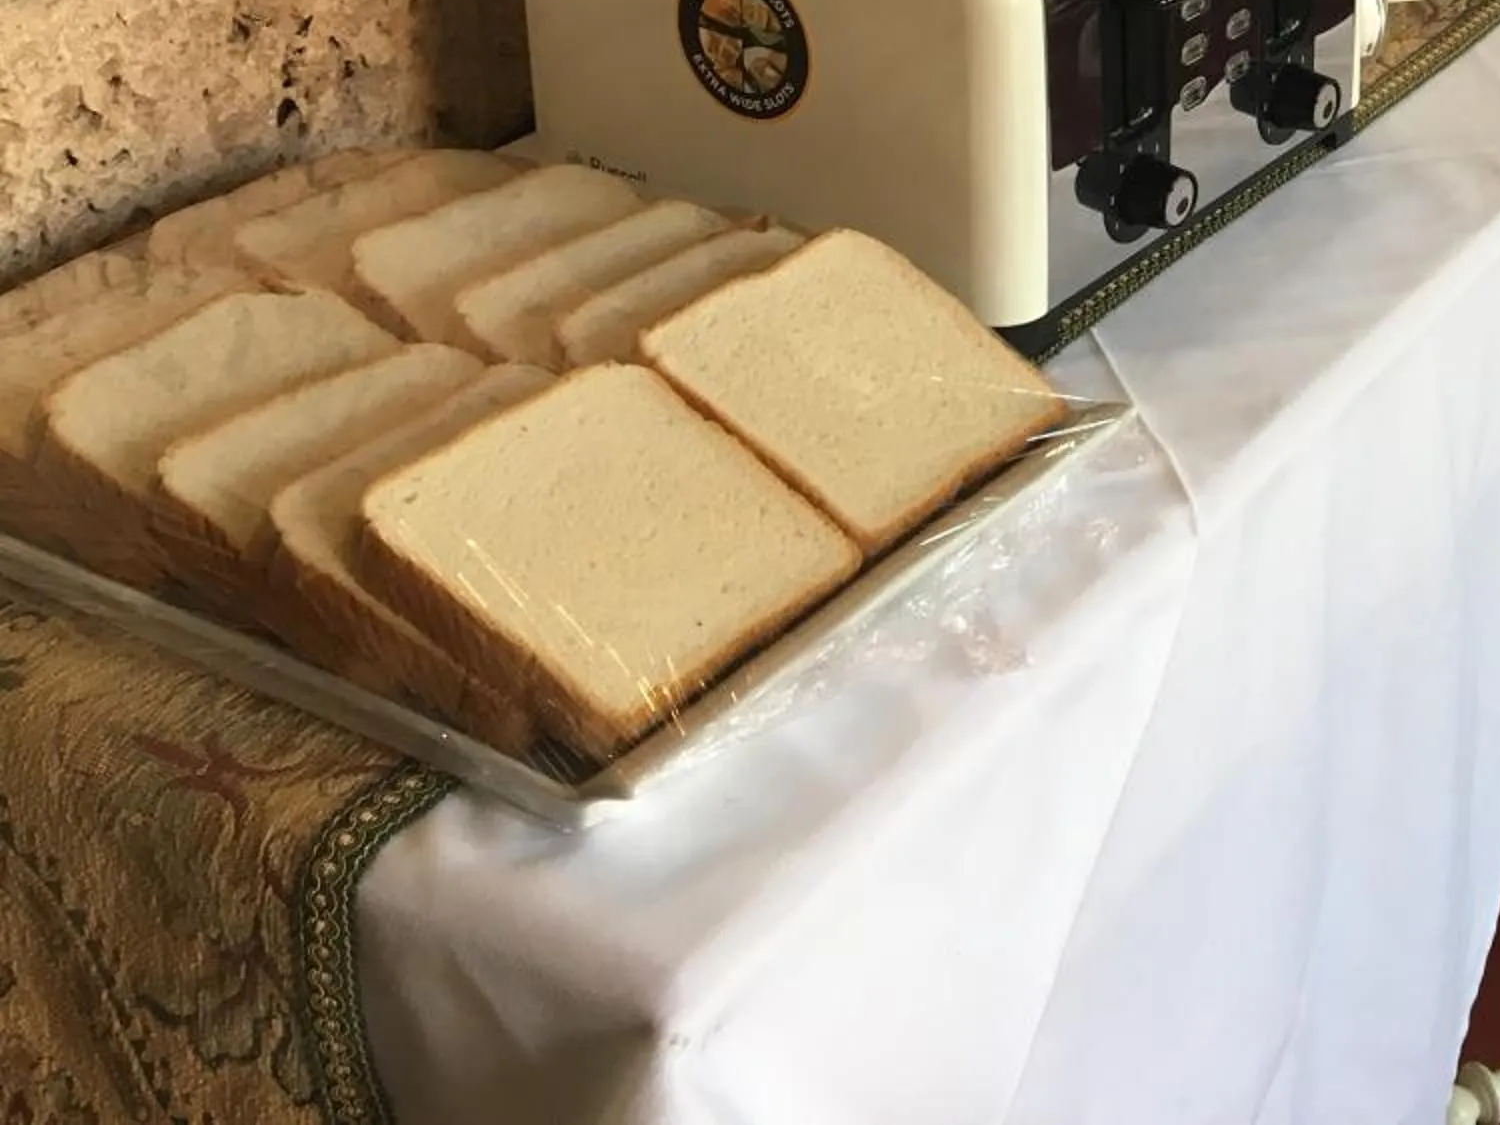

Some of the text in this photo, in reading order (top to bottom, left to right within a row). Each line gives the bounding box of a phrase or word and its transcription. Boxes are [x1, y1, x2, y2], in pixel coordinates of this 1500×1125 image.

[692, 53, 796, 113] EXTRA WIDE SLOTS
